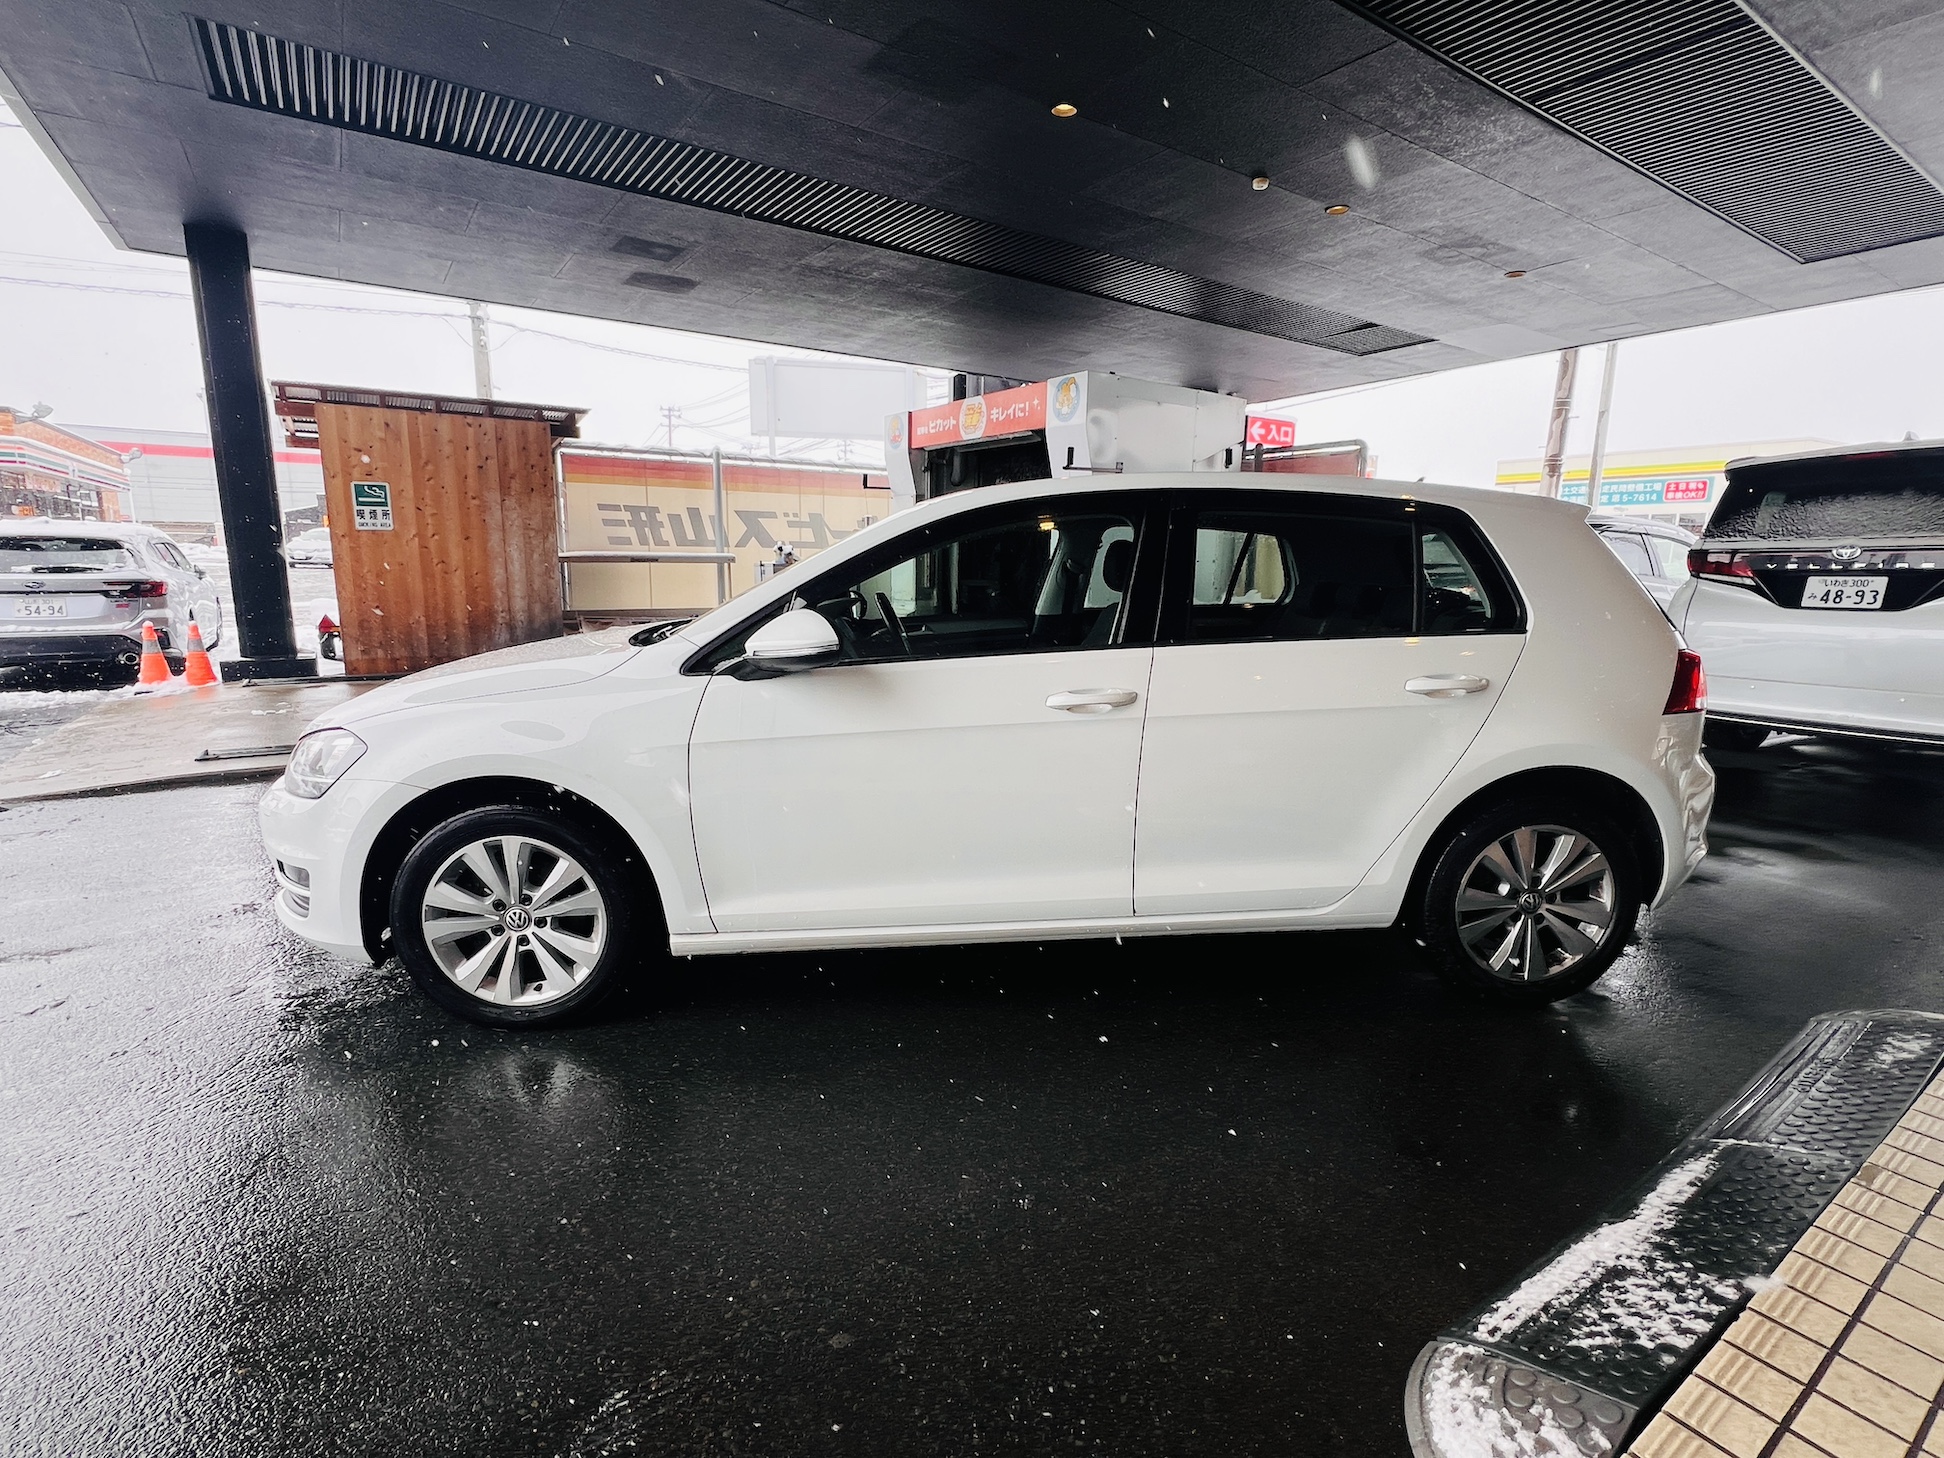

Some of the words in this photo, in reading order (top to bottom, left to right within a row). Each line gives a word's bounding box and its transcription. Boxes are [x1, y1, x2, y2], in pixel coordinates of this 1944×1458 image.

[990, 401, 1029, 422] キレイに!
[1267, 424, 1292, 442] 入口
[356, 509, 391, 520] 喫煙所
[1819, 589, 1879, 605] 48-93
[24, 605, 64, 616] 54-94
